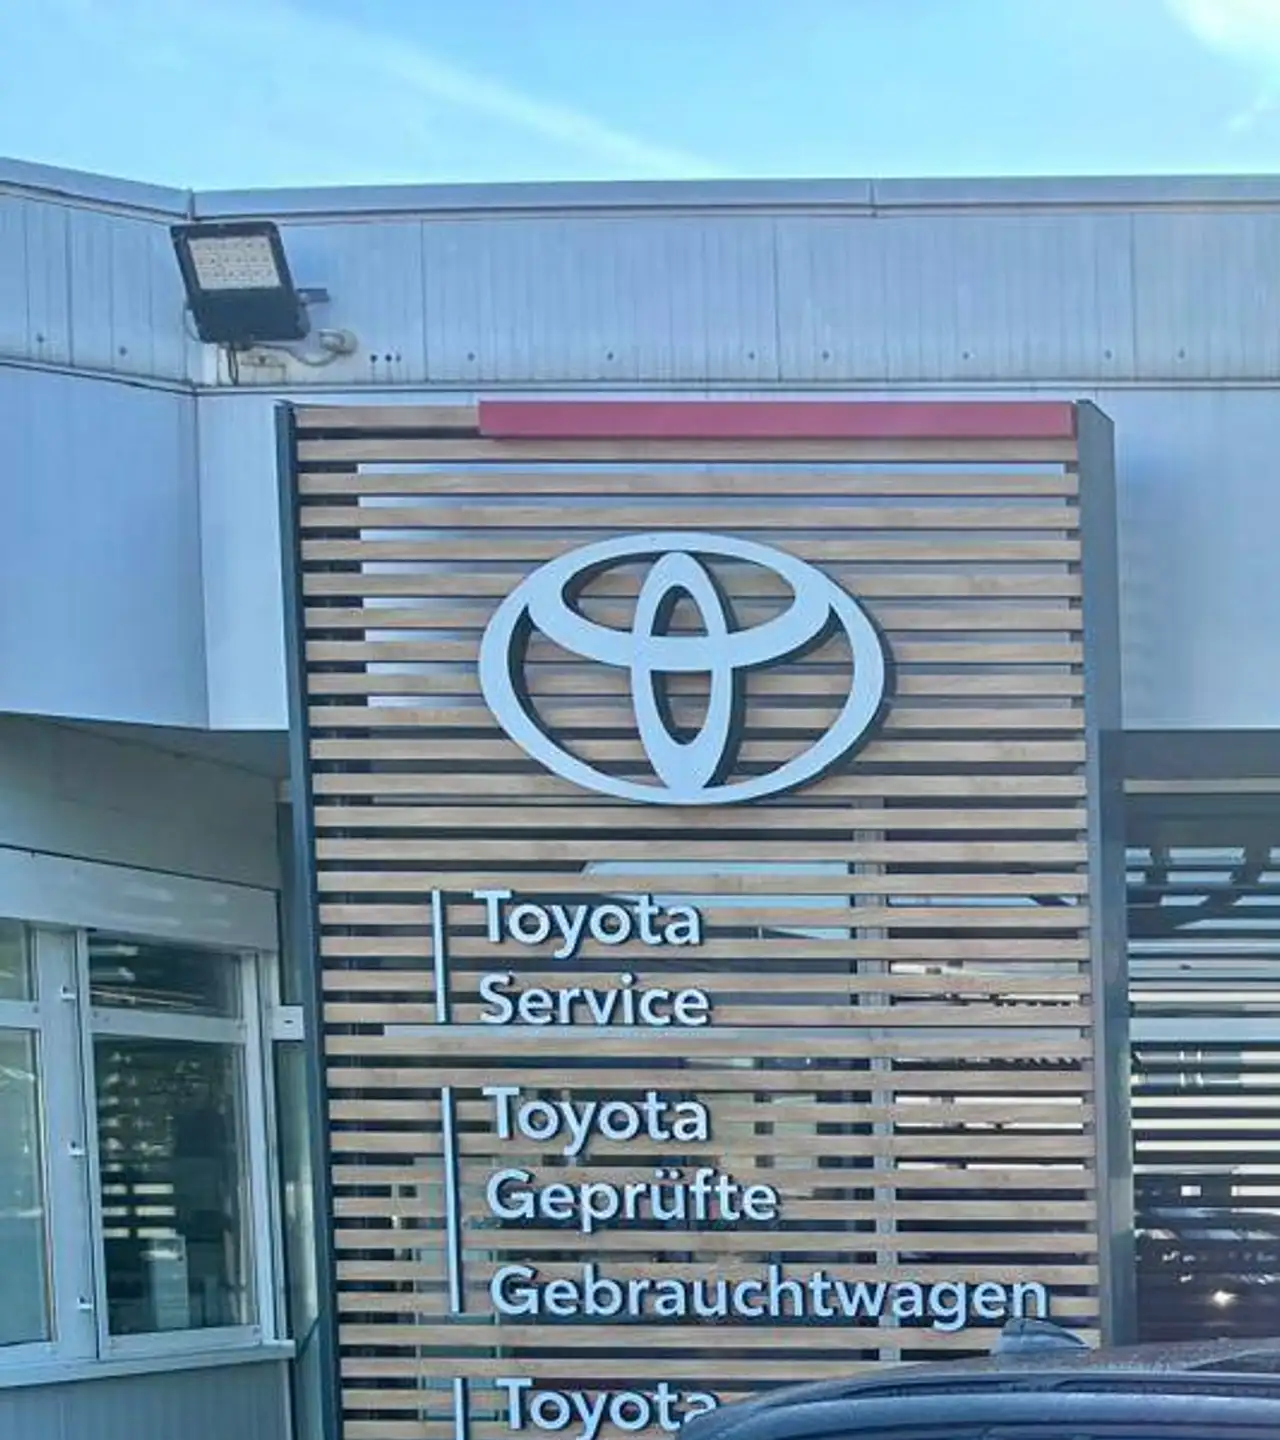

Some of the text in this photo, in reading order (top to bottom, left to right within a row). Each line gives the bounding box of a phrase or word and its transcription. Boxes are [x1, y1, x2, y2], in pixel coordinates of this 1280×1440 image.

[473, 889, 702, 960] Toyota
[479, 971, 711, 1026] Service
[483, 1086, 711, 1157] Toyota
[486, 1167, 780, 1235] Geprüfte
[489, 1264, 1050, 1331] Gebrauchtwagen
